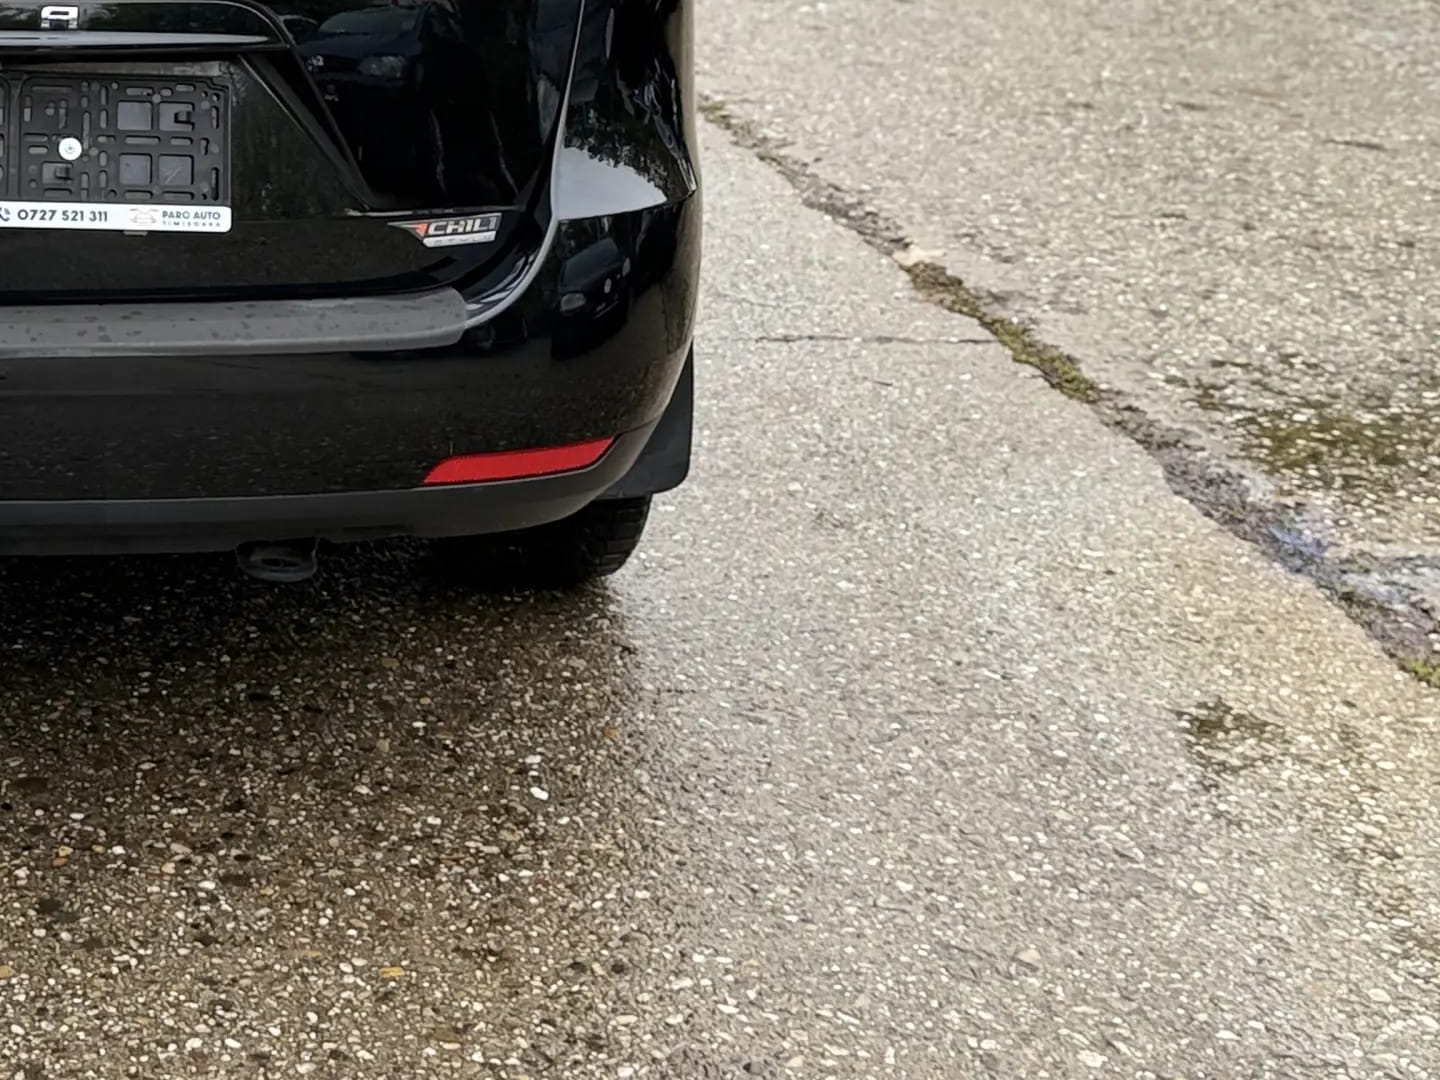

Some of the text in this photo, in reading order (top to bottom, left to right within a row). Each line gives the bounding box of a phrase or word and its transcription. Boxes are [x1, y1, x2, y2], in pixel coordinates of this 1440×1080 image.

[17, 209, 108, 223] 0727 521 311
[193, 211, 221, 220] AUTO
[427, 217, 498, 236] CHILI
